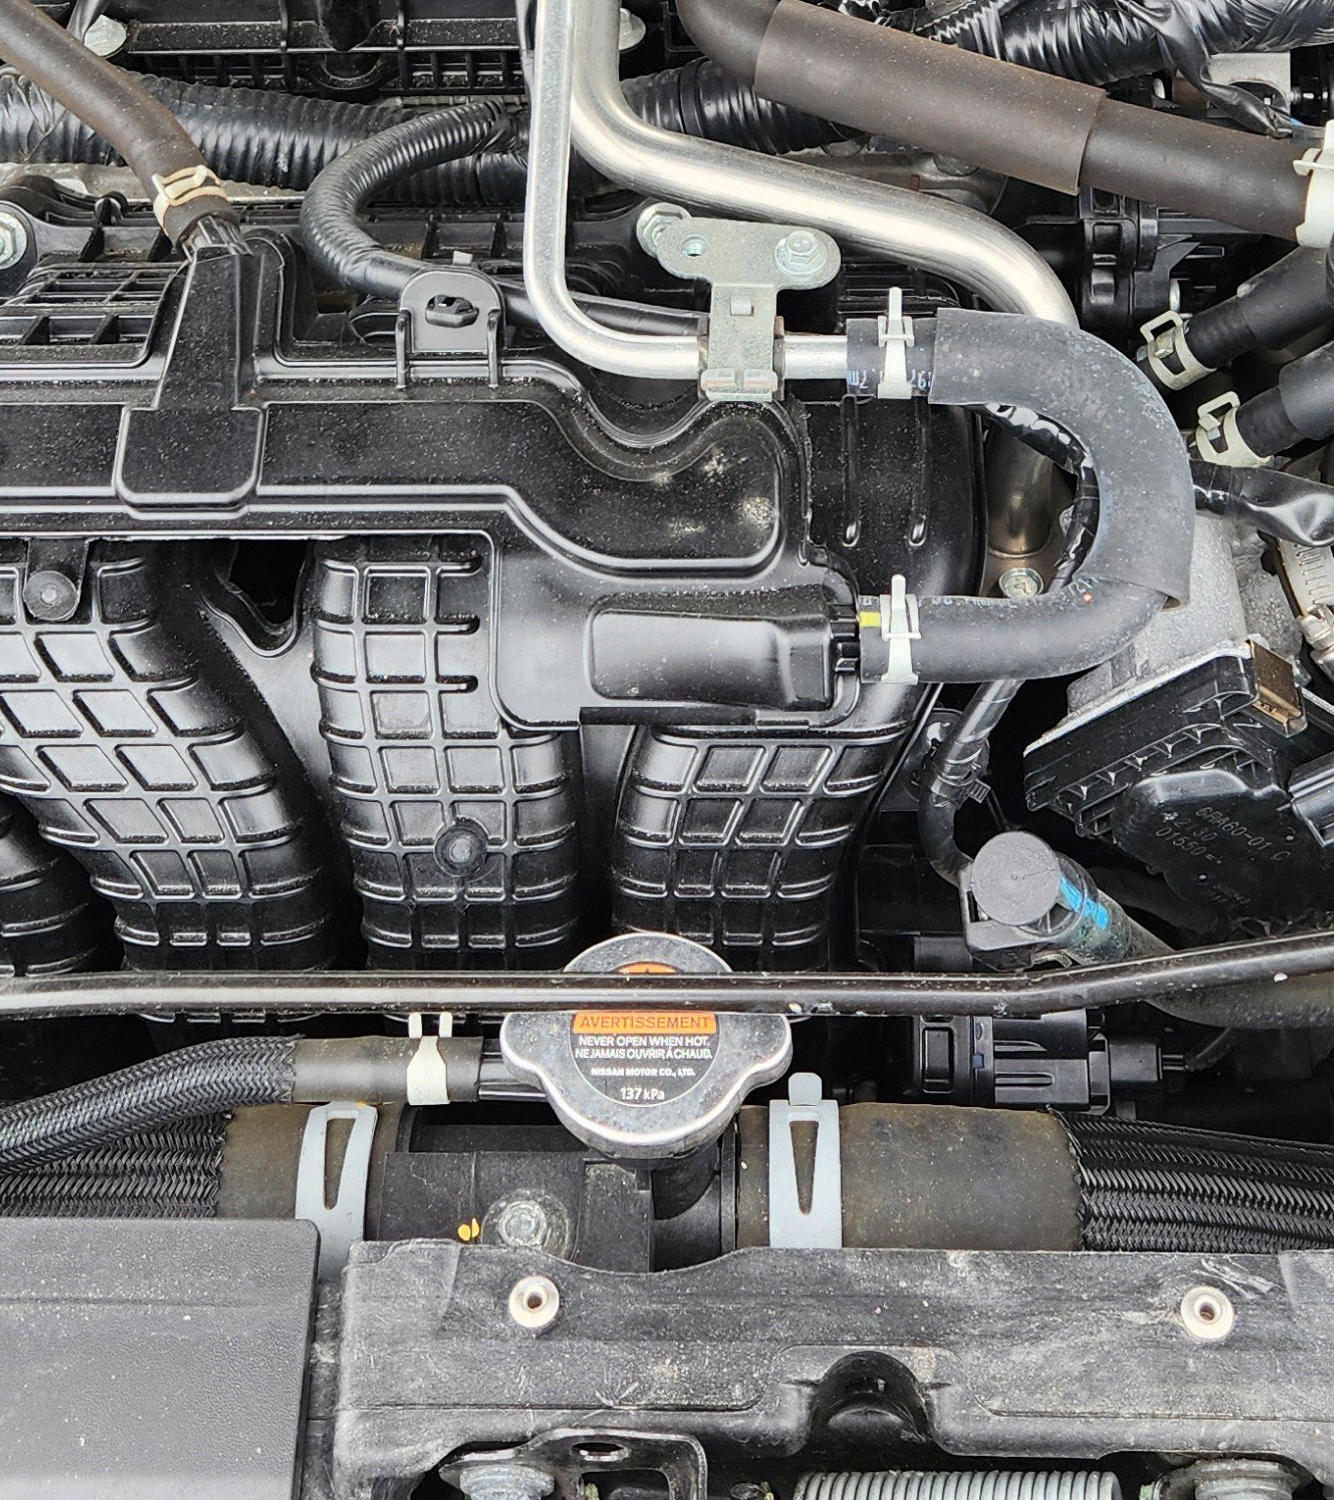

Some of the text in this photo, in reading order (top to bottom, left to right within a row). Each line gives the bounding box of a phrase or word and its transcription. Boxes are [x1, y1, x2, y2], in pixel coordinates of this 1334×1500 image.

[579, 1016, 709, 1029] AVERTISSEMENT
[579, 1036, 710, 1046] NEVER OPEN WHEN HOT.
[626, 1049, 664, 1059] OUVRIR
[591, 1068, 623, 1077] NISSAN
[626, 1068, 656, 1077] MOTOR
[620, 1088, 665, 1100] 137 kPa
